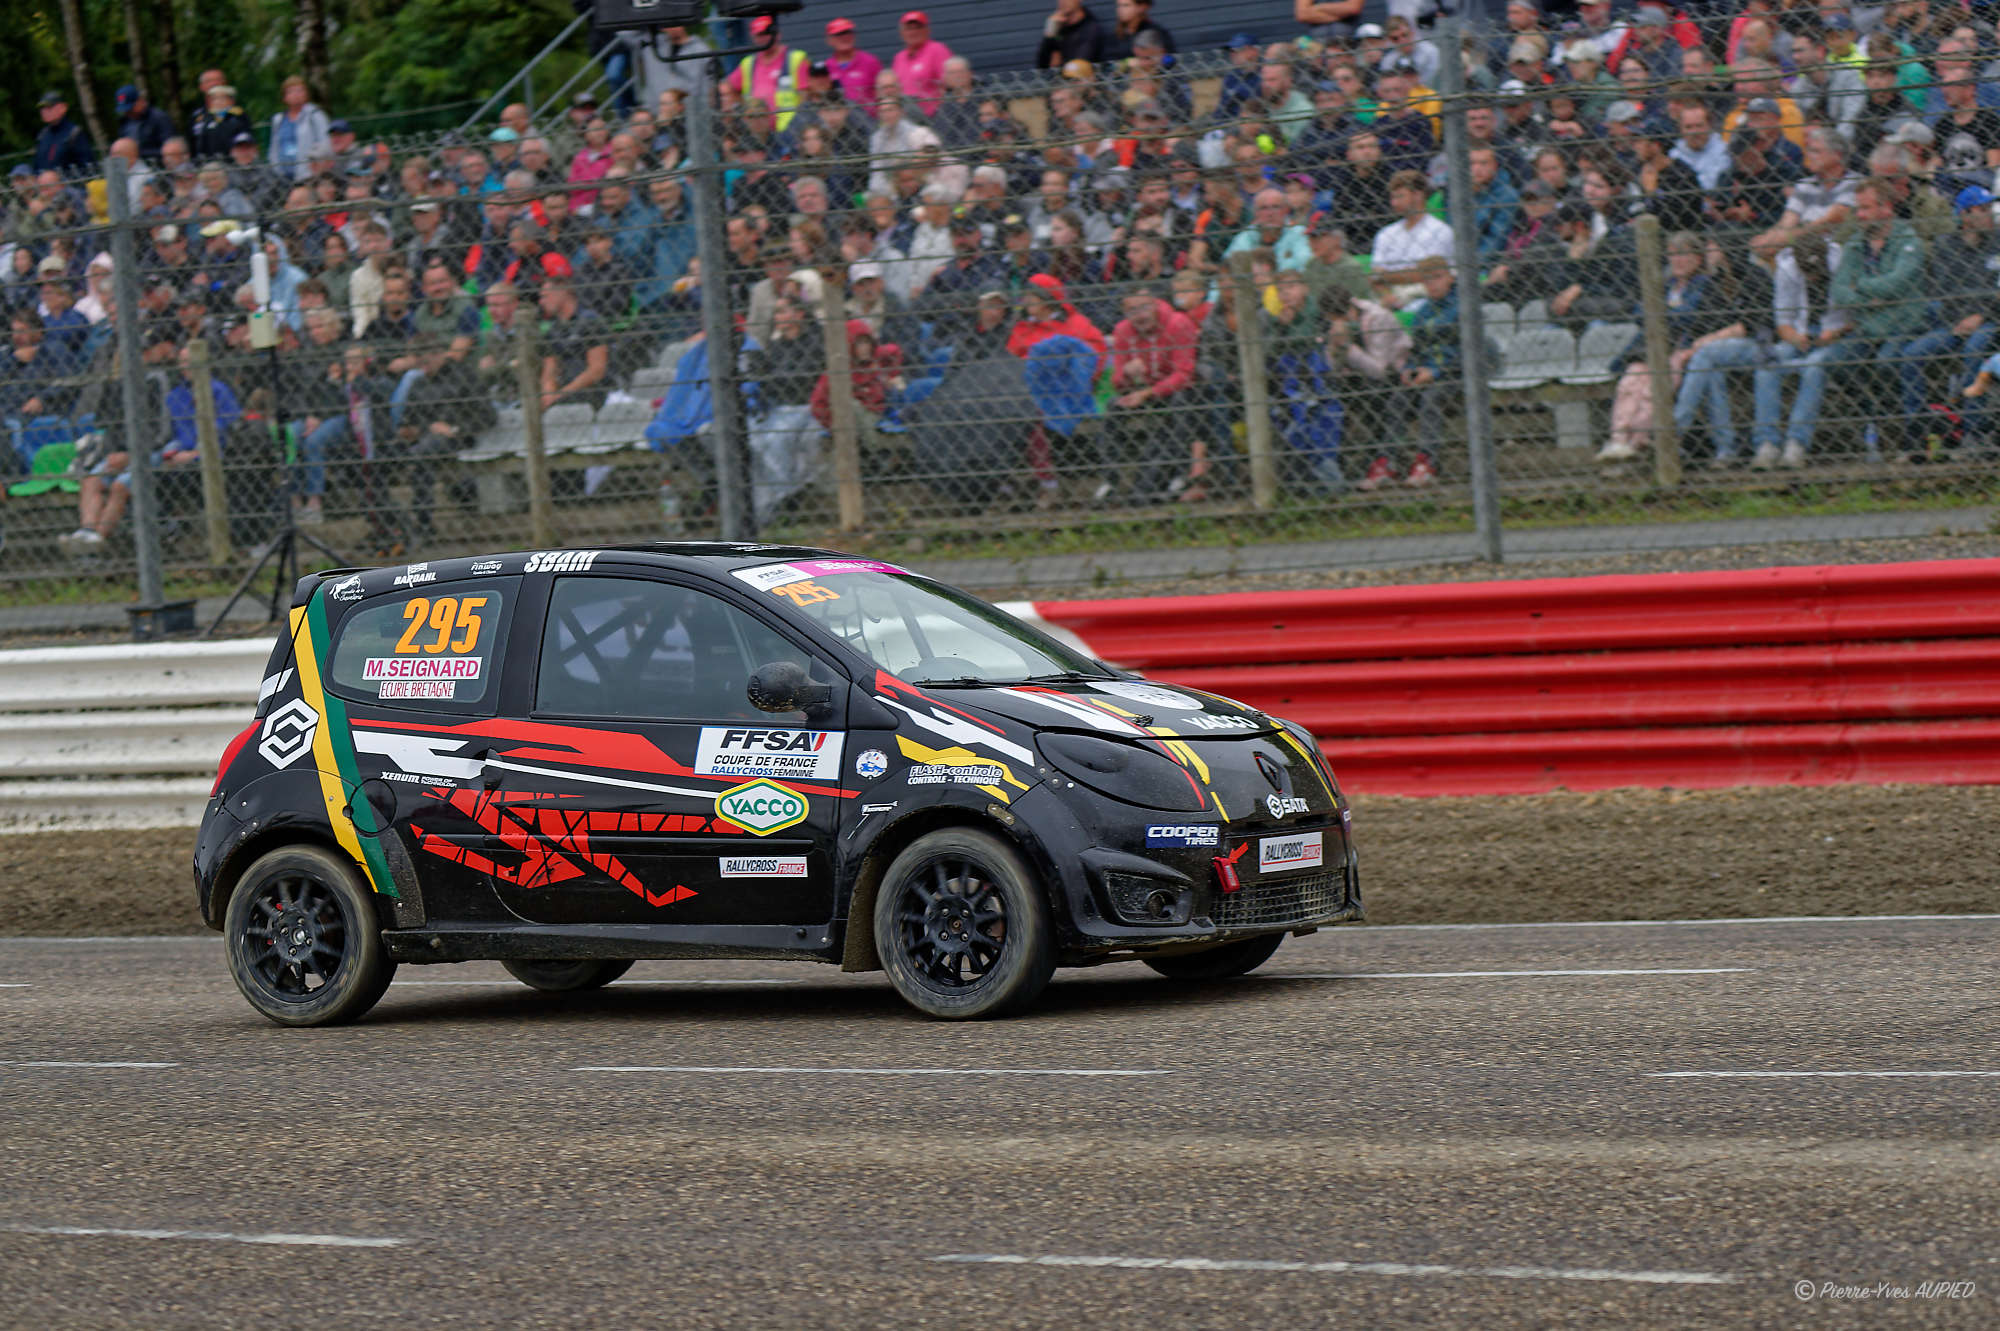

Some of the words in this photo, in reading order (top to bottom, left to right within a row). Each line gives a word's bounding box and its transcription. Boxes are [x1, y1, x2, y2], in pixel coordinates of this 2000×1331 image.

[393, 572, 437, 588] BARDAHL
[771, 580, 840, 607] 295
[395, 597, 488, 653] 295
[366, 660, 479, 678] M.SEIGNARD
[381, 681, 409, 697] ECURIE
[410, 681, 453, 697] BRETAGNE
[1181, 714, 1260, 730] YACCO
[720, 729, 811, 751] FFSA
[714, 755, 752, 766] COUPE
[755, 756, 772, 766] DE
[773, 757, 818, 768] FRANCE
[907, 776, 947, 785] CONTROLE
[953, 775, 1001, 786] TECHNIQUE
[728, 798, 797, 816] YACCO
[1281, 797, 1310, 814] SATA
[1148, 826, 1219, 838] COOPER
[1184, 837, 1218, 846] TIRES
[1264, 842, 1303, 862] RALLYCROSS
[726, 860, 777, 872] RALLYCROSS
